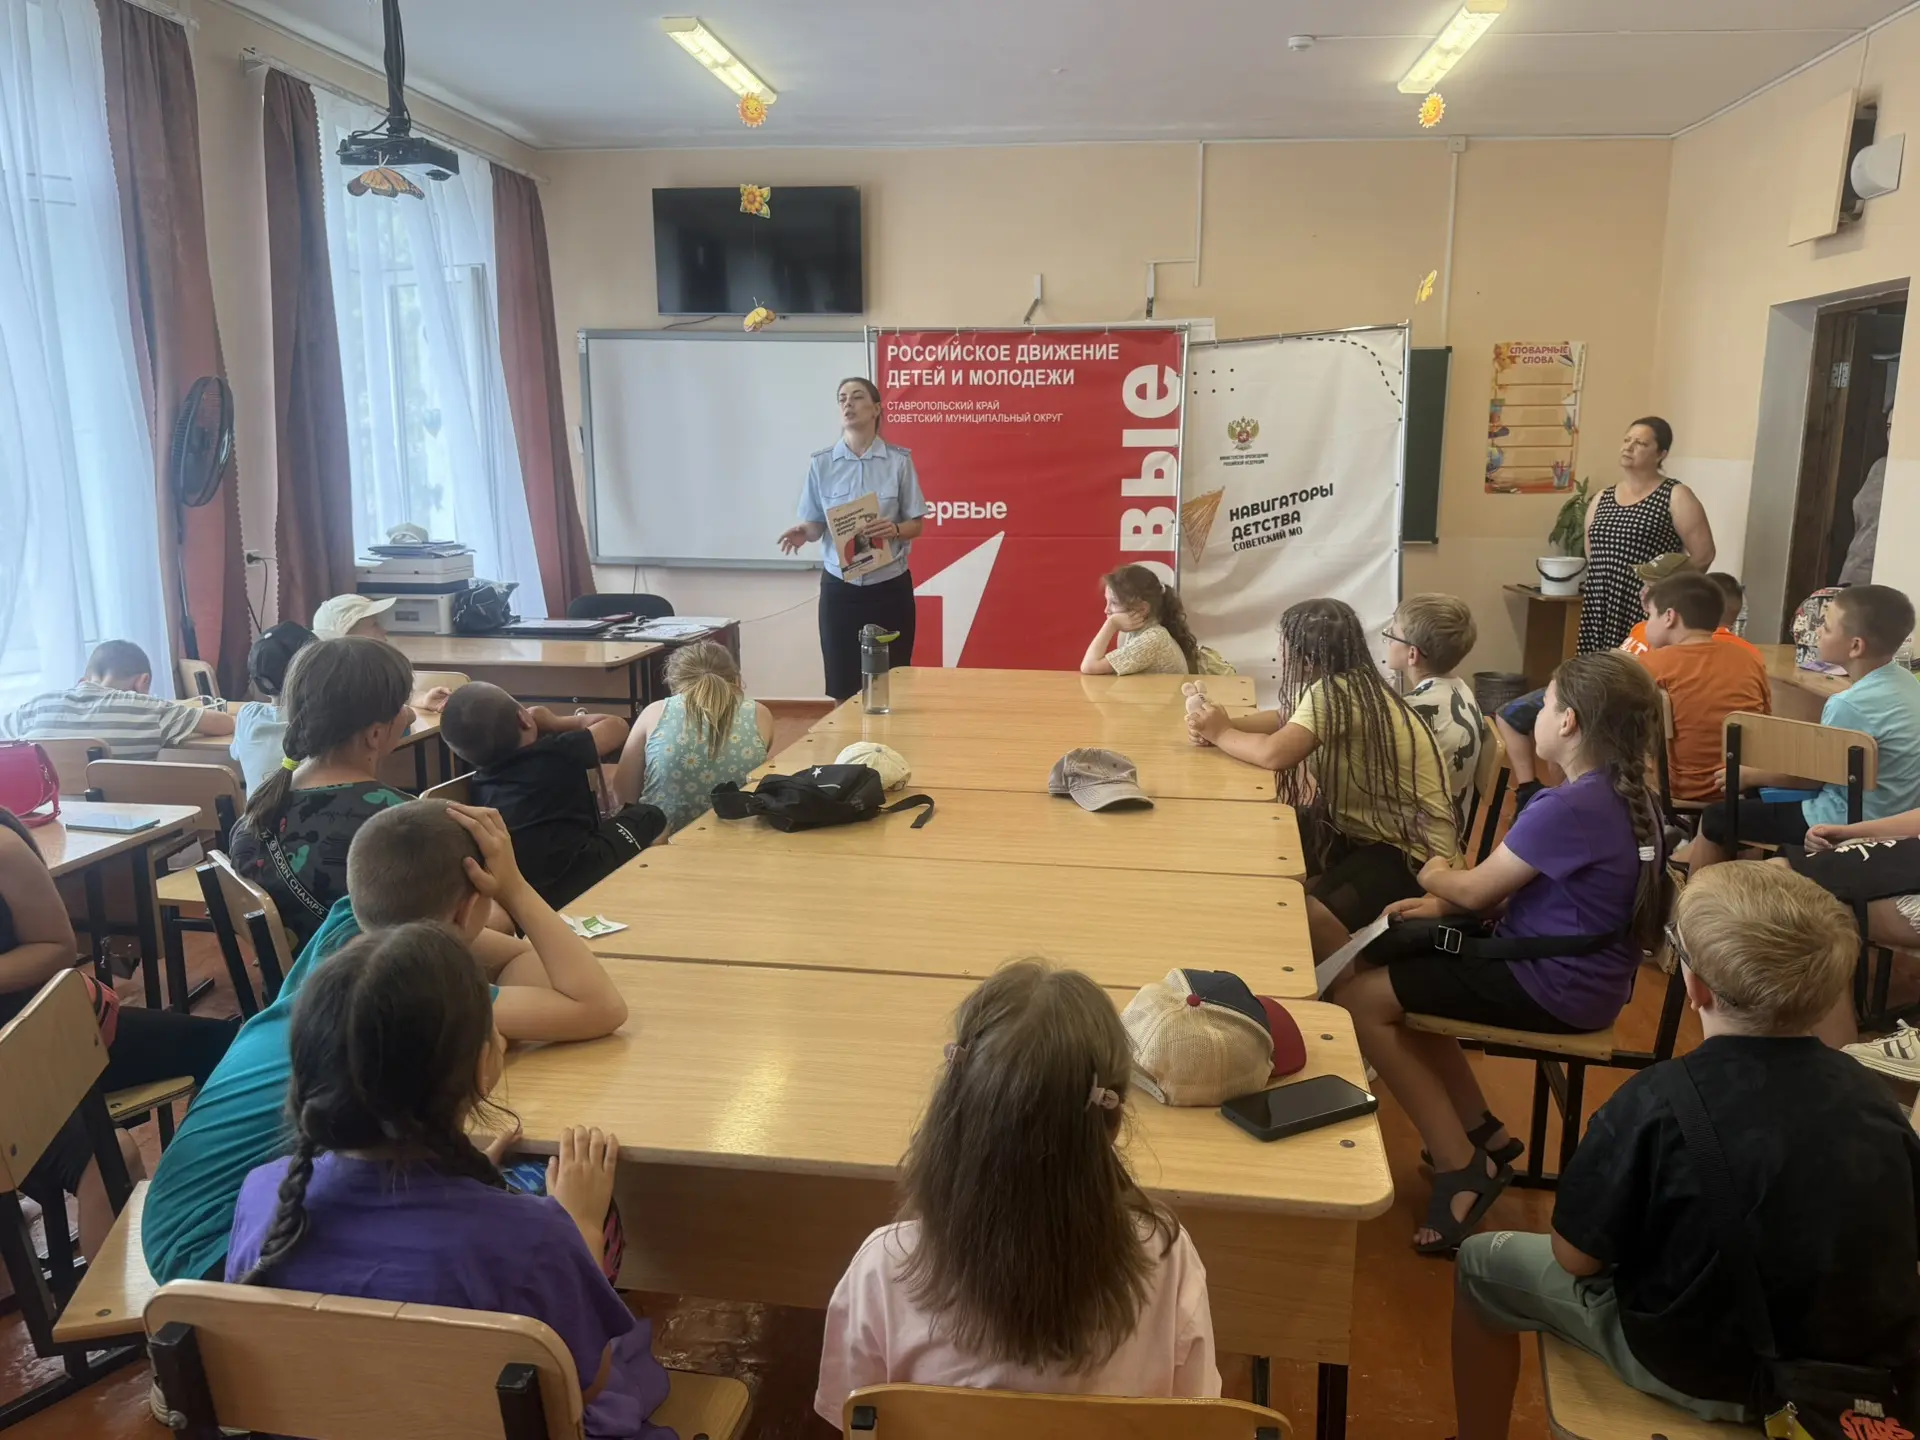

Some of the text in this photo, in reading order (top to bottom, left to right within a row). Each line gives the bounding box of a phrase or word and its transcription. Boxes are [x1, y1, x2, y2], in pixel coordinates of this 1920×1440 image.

[887, 340, 1120, 363] РОССИЙСКОЕ ДВИЖЕНИЕ
[1509, 346, 1569, 355] СЛОВАРНЫЕ
[1522, 355, 1554, 364] СЛОВА
[886, 365, 1076, 389] ДЕТЕЙ И МОЛОДЕЖИ
[886, 399, 1001, 411] СТАВРОПОЛЬСКИЙ КРАЙ
[886, 411, 1064, 424] СОВЕТСКИЙ МУНИЦИПАЛЬНЫЙ ОКРУГ
[1119, 363, 1182, 588] вые
[923, 500, 1008, 526] ервые
[1229, 482, 1334, 522] НАВИГАТОРЫ
[1231, 510, 1301, 542] ДЕТСТВА
[1233, 526, 1303, 552] СОВЕТСКИЙ МО
[273, 850, 325, 915] BORN CHAMPS
